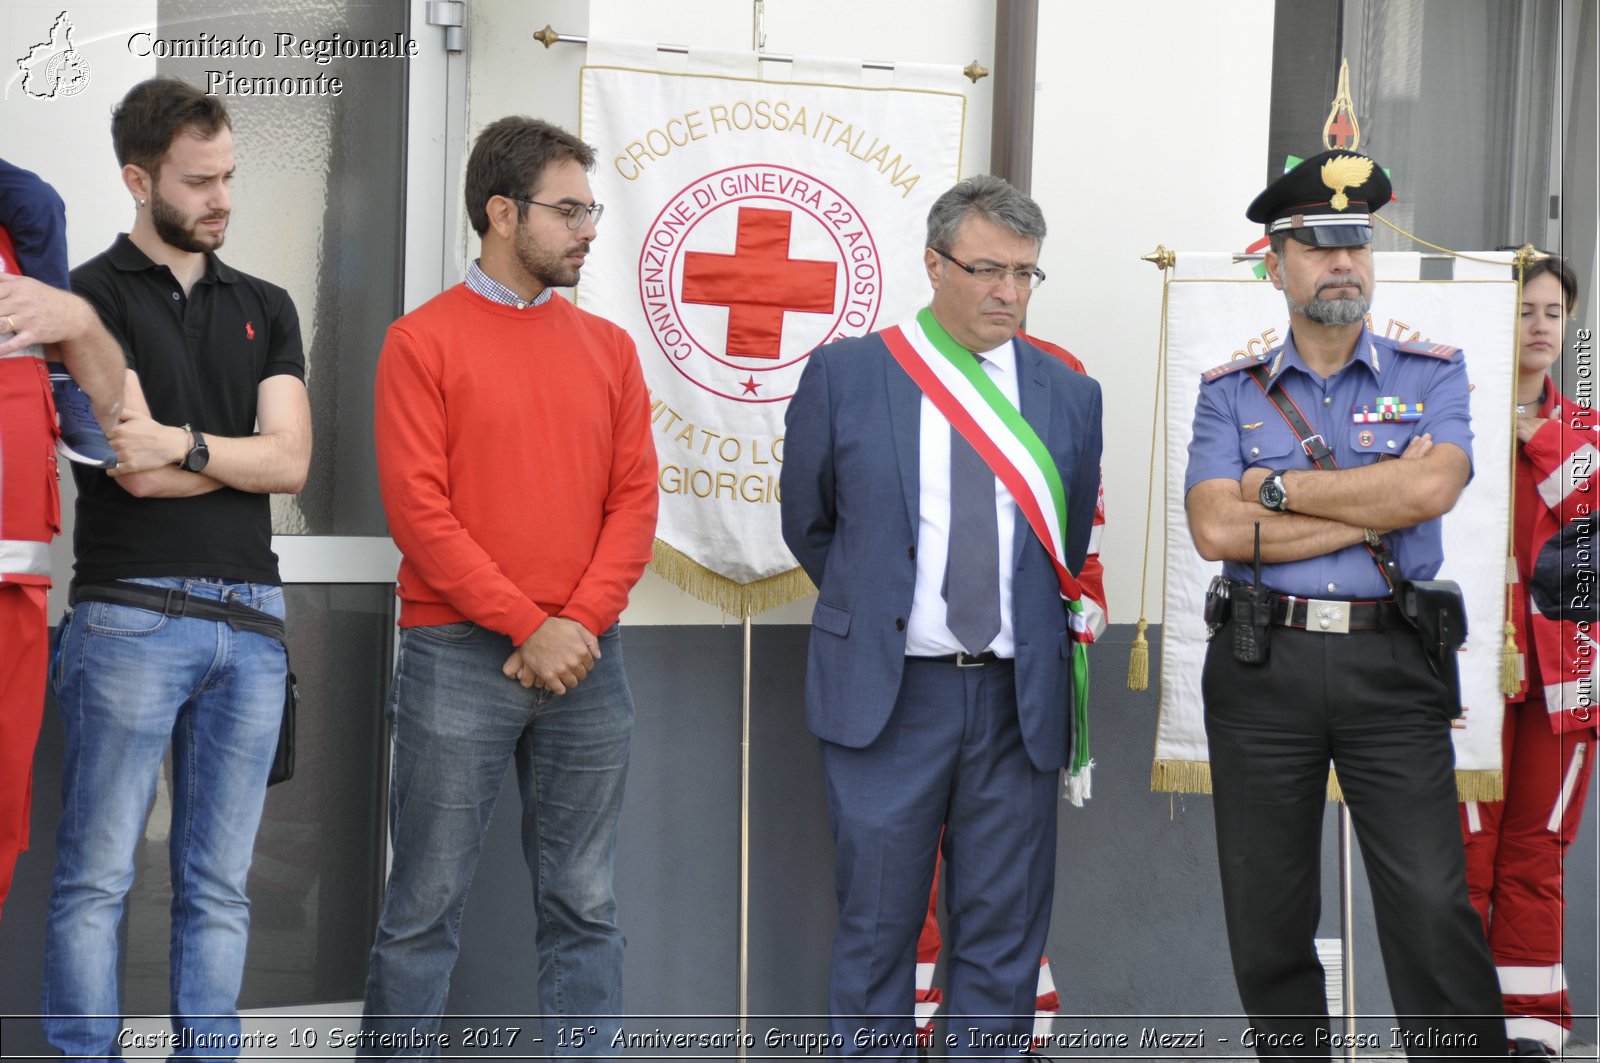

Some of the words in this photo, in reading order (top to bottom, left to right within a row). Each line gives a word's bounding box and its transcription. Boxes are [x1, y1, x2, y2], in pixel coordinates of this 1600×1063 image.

[614, 110, 708, 181] CROCE
[709, 99, 808, 135] ROSSA
[811, 112, 922, 199] ITALIANA
[644, 200, 697, 360] CONVENZIONE
[692, 183, 718, 210] DI
[720, 172, 823, 210] GINEVRA
[823, 200, 853, 230] 22
[844, 230, 876, 328] AGOSTO
